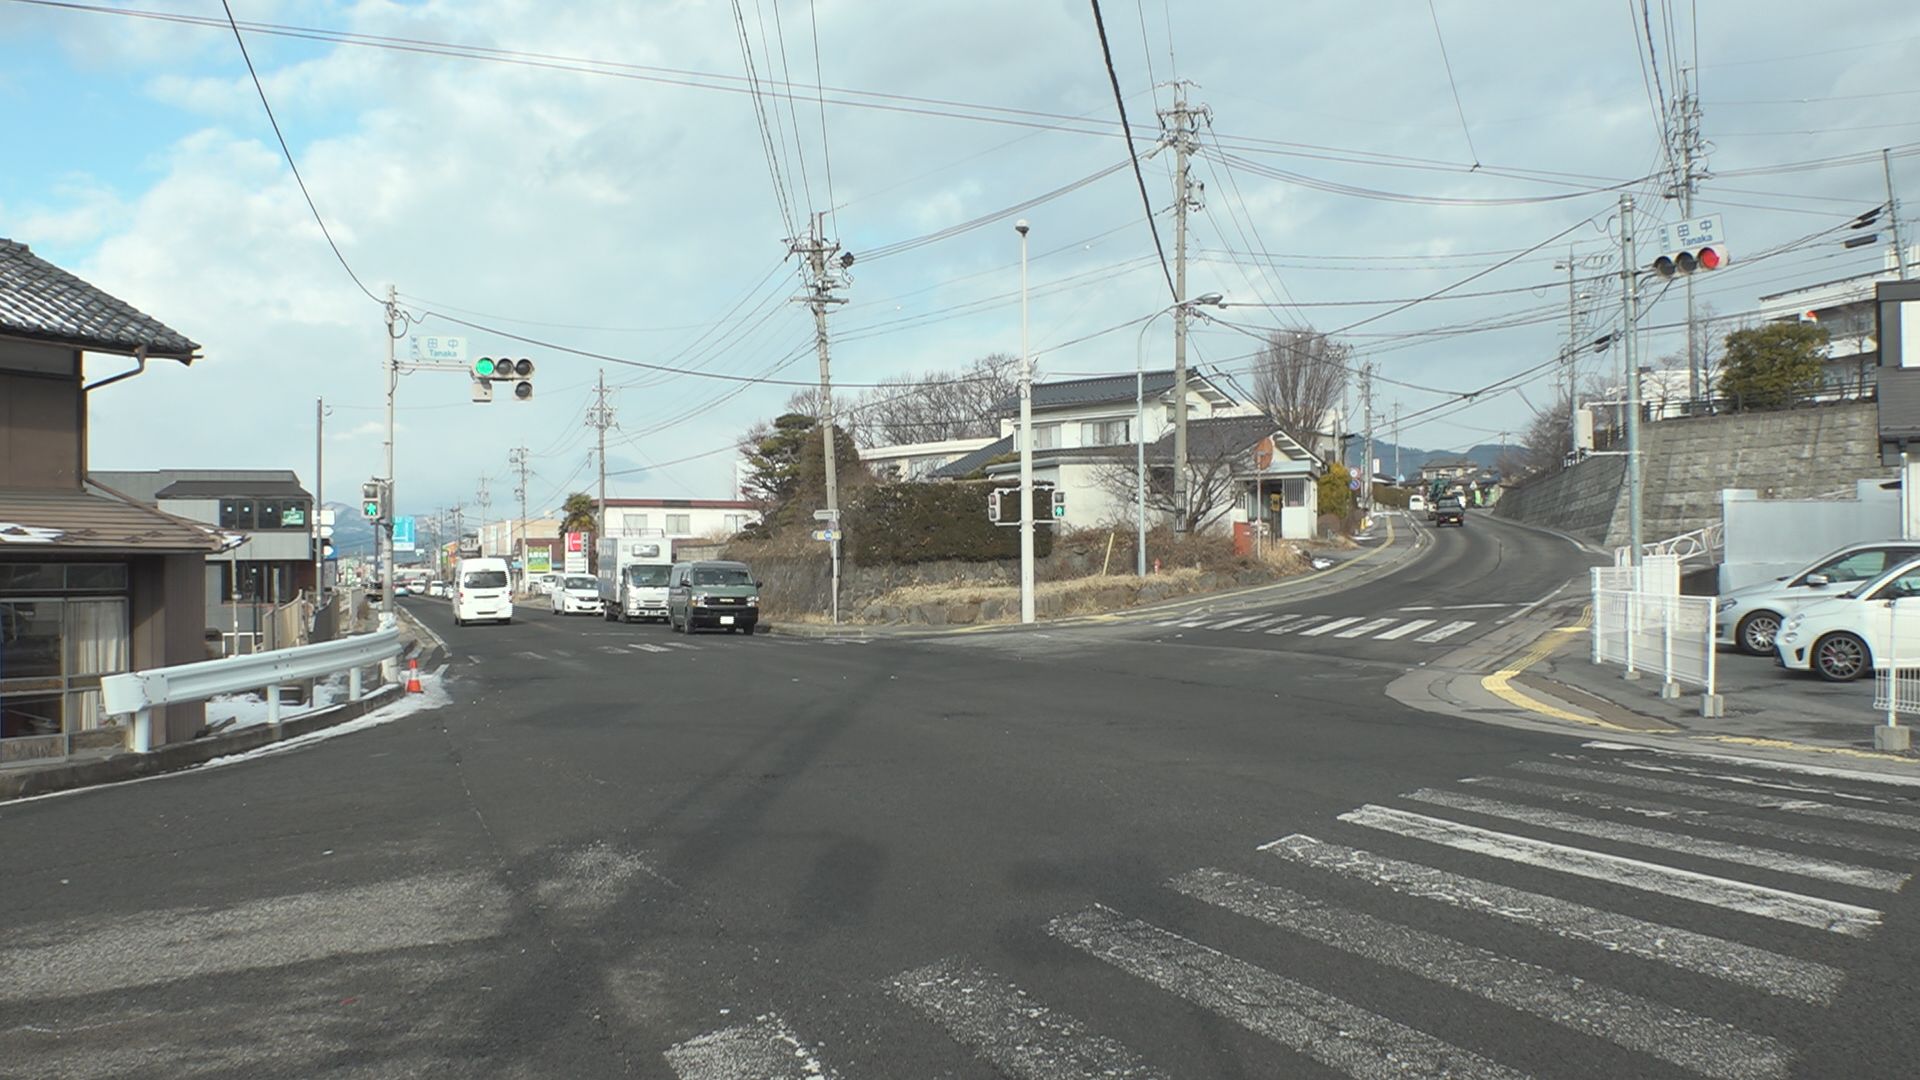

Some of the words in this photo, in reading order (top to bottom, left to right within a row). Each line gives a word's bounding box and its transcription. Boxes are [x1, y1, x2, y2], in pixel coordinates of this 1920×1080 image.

[1677, 220, 1712, 237] 田中
[1680, 234, 1713, 247] Tanaka
[427, 338, 459, 349] 田中
[429, 349, 457, 357] Tanaka
